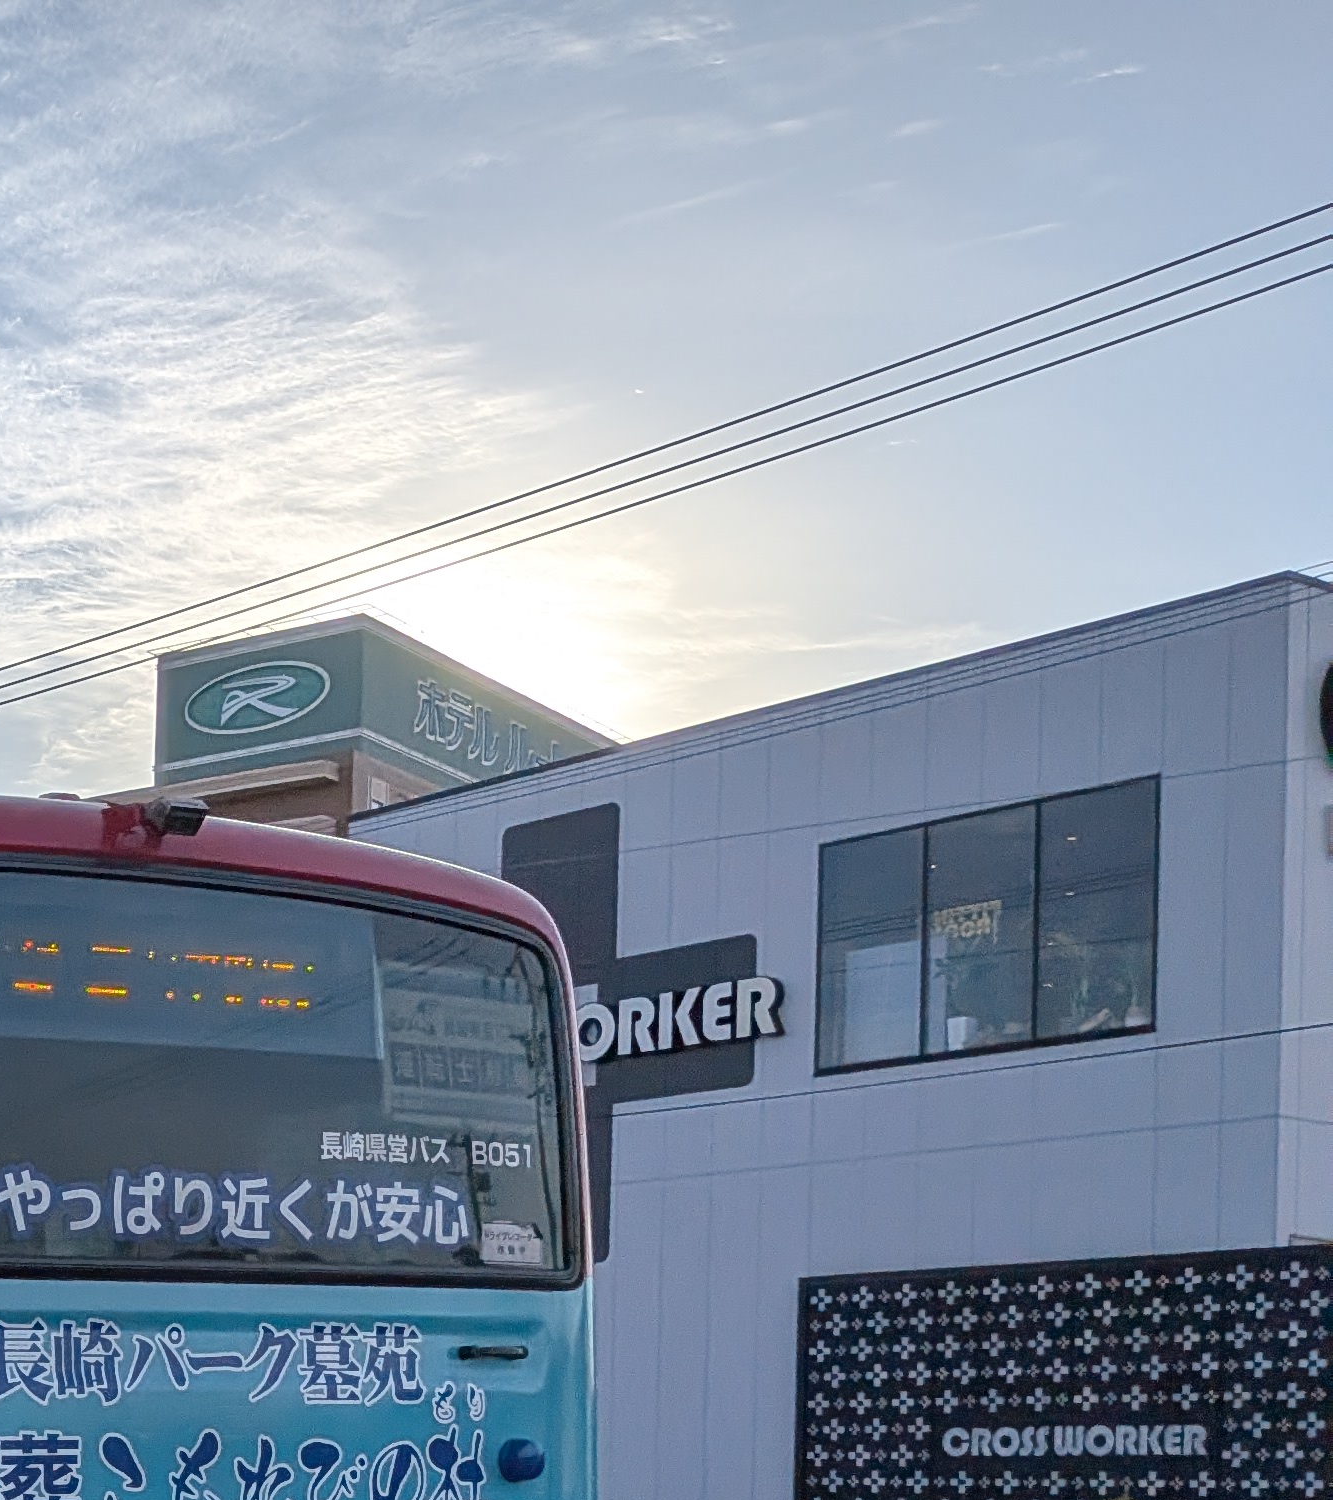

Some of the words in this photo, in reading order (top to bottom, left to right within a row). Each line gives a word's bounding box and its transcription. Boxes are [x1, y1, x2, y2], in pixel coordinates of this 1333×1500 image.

[320, 1131, 450, 1164] 長崎県営バス
[471, 1140, 531, 1168] B051
[432, 1381, 485, 1424] もり
